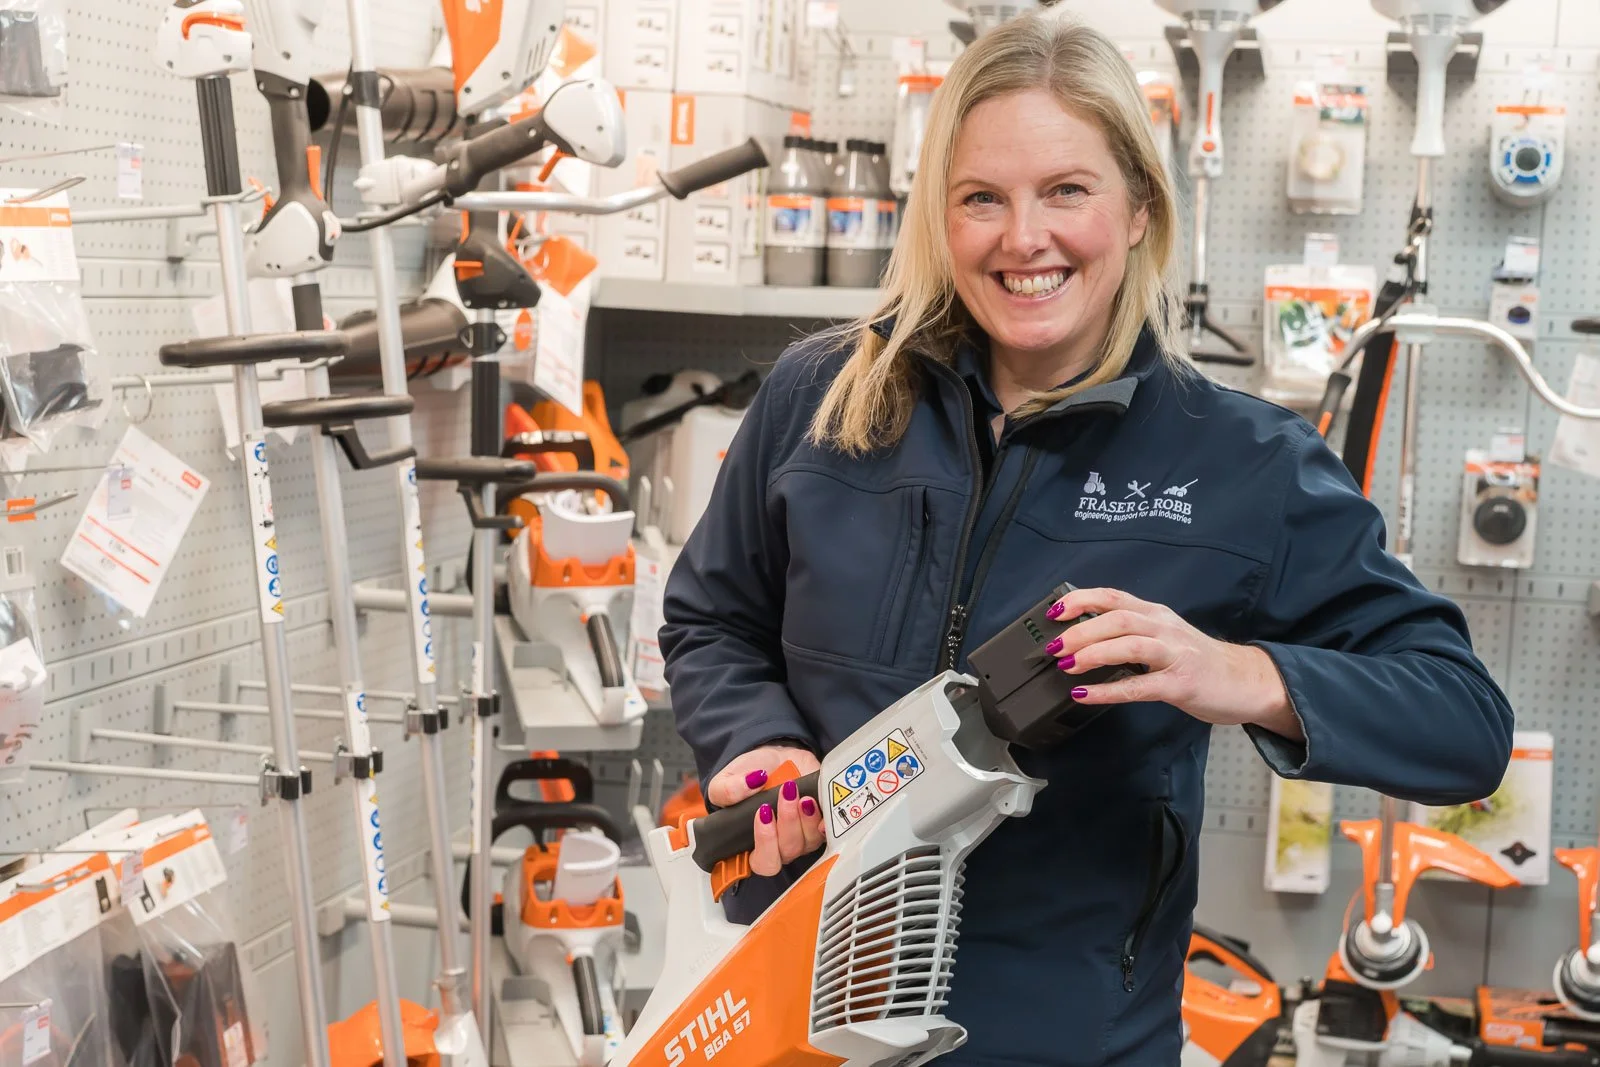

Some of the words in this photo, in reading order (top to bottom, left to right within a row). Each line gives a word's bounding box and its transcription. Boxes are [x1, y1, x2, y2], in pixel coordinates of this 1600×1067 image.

[1074, 510, 1113, 523] engineering
[1113, 513, 1138, 522] support
[1149, 509, 1158, 517] all
[1158, 509, 1193, 524] industries
[1078, 497, 1136, 513] FRASER
[1137, 501, 1150, 511] C.
[1153, 498, 1193, 515] ROBB
[664, 989, 747, 1067] STIHL
[703, 1029, 732, 1060] BGA
[733, 1010, 750, 1034] 57
